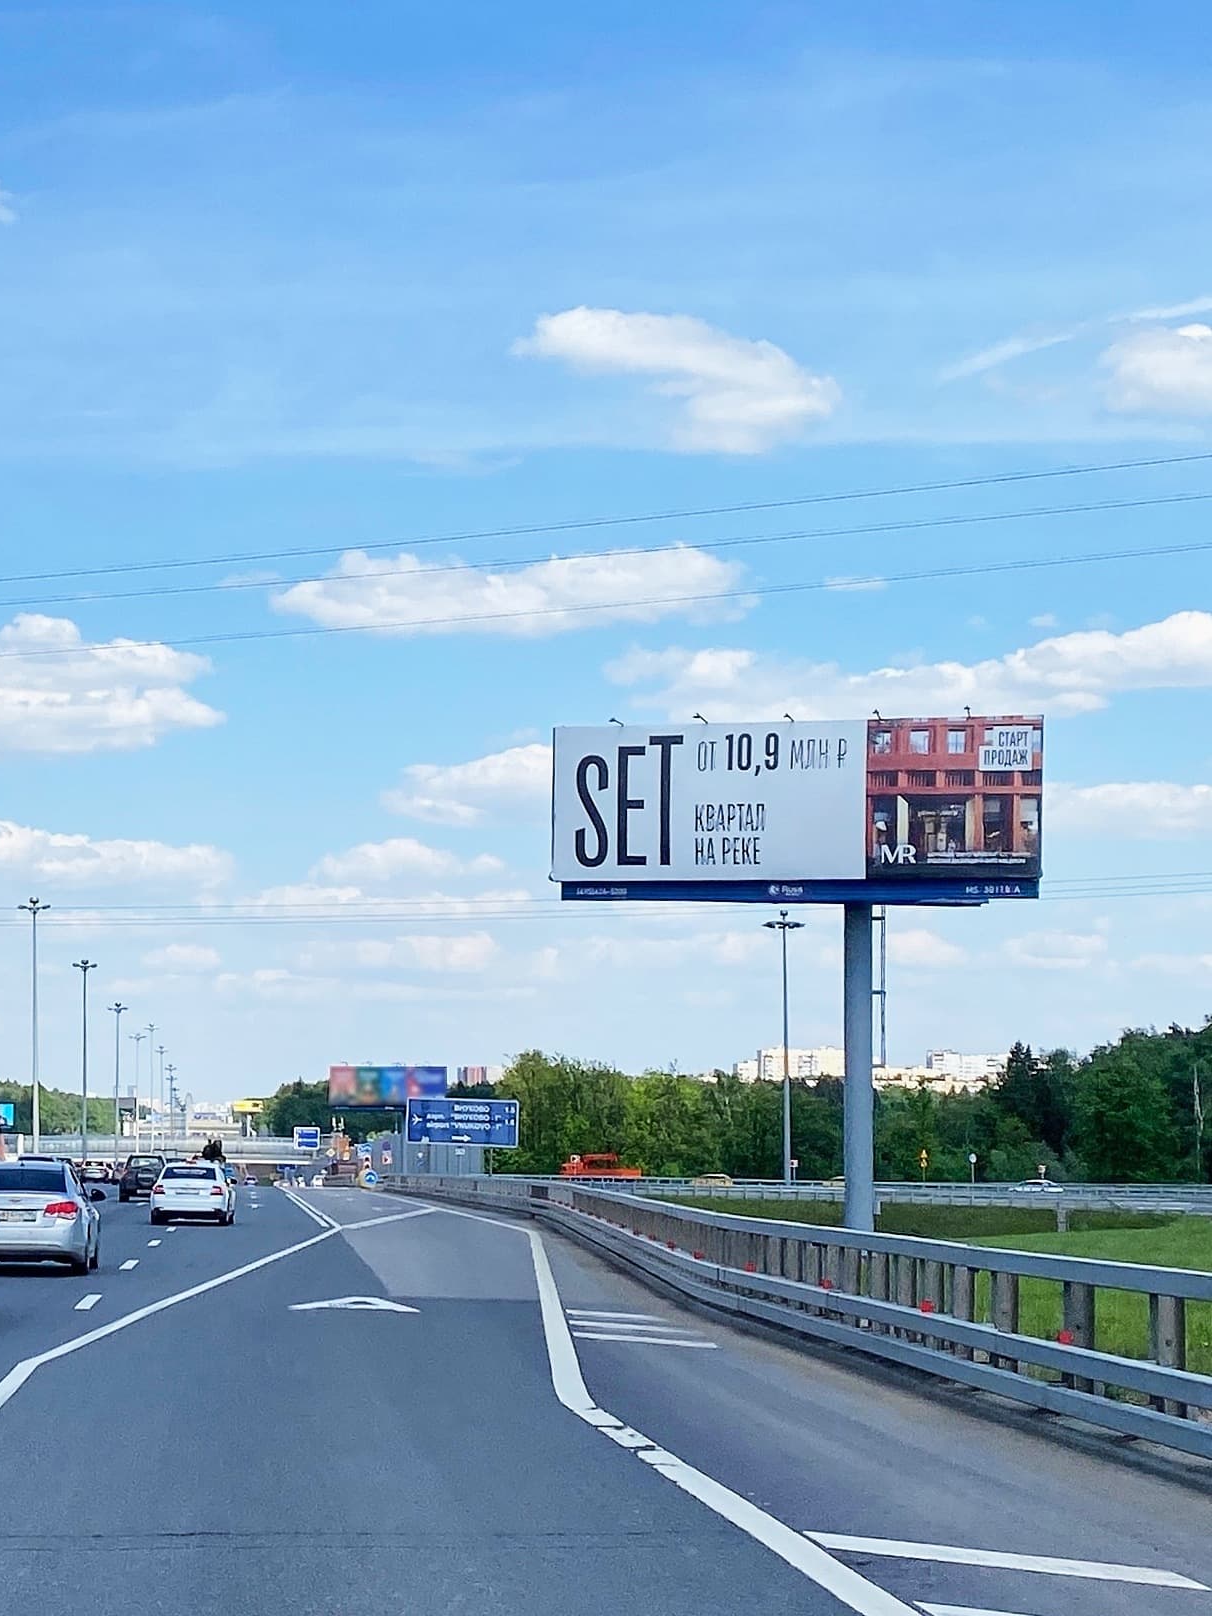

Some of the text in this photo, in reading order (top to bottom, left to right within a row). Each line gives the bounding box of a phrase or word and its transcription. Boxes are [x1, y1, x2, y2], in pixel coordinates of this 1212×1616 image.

[998, 731, 1029, 747] СТАРТ
[698, 741, 717, 771] ОТ
[725, 733, 779, 776] 10,9
[790, 739, 829, 770] МЛН
[983, 749, 1028, 767] ПРОДАЖ
[575, 735, 684, 867] SET
[694, 803, 765, 832] КВАРТАЛ
[694, 836, 761, 865] НА РЕКЕ
[881, 844, 916, 864] MR
